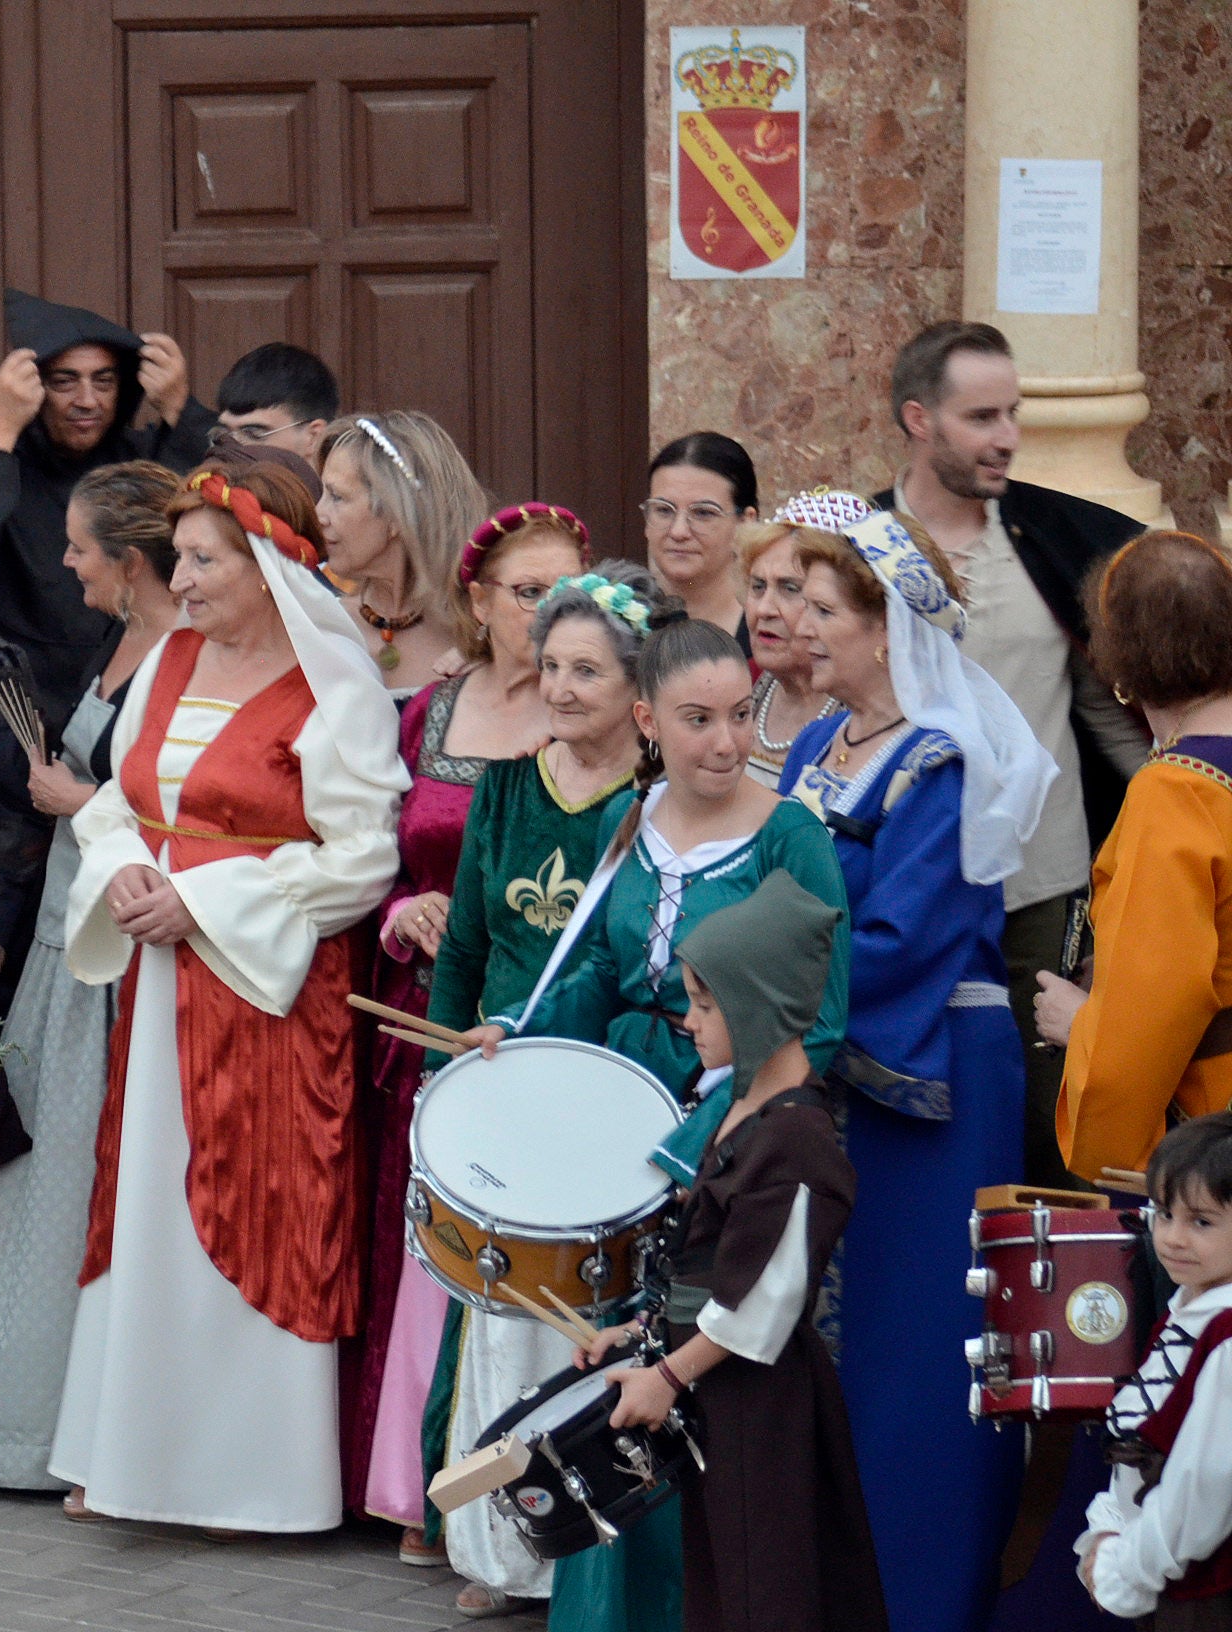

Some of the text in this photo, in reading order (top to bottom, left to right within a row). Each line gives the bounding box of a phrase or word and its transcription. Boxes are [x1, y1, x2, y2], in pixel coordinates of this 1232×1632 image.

[683, 117, 784, 248] Reino de Granada
